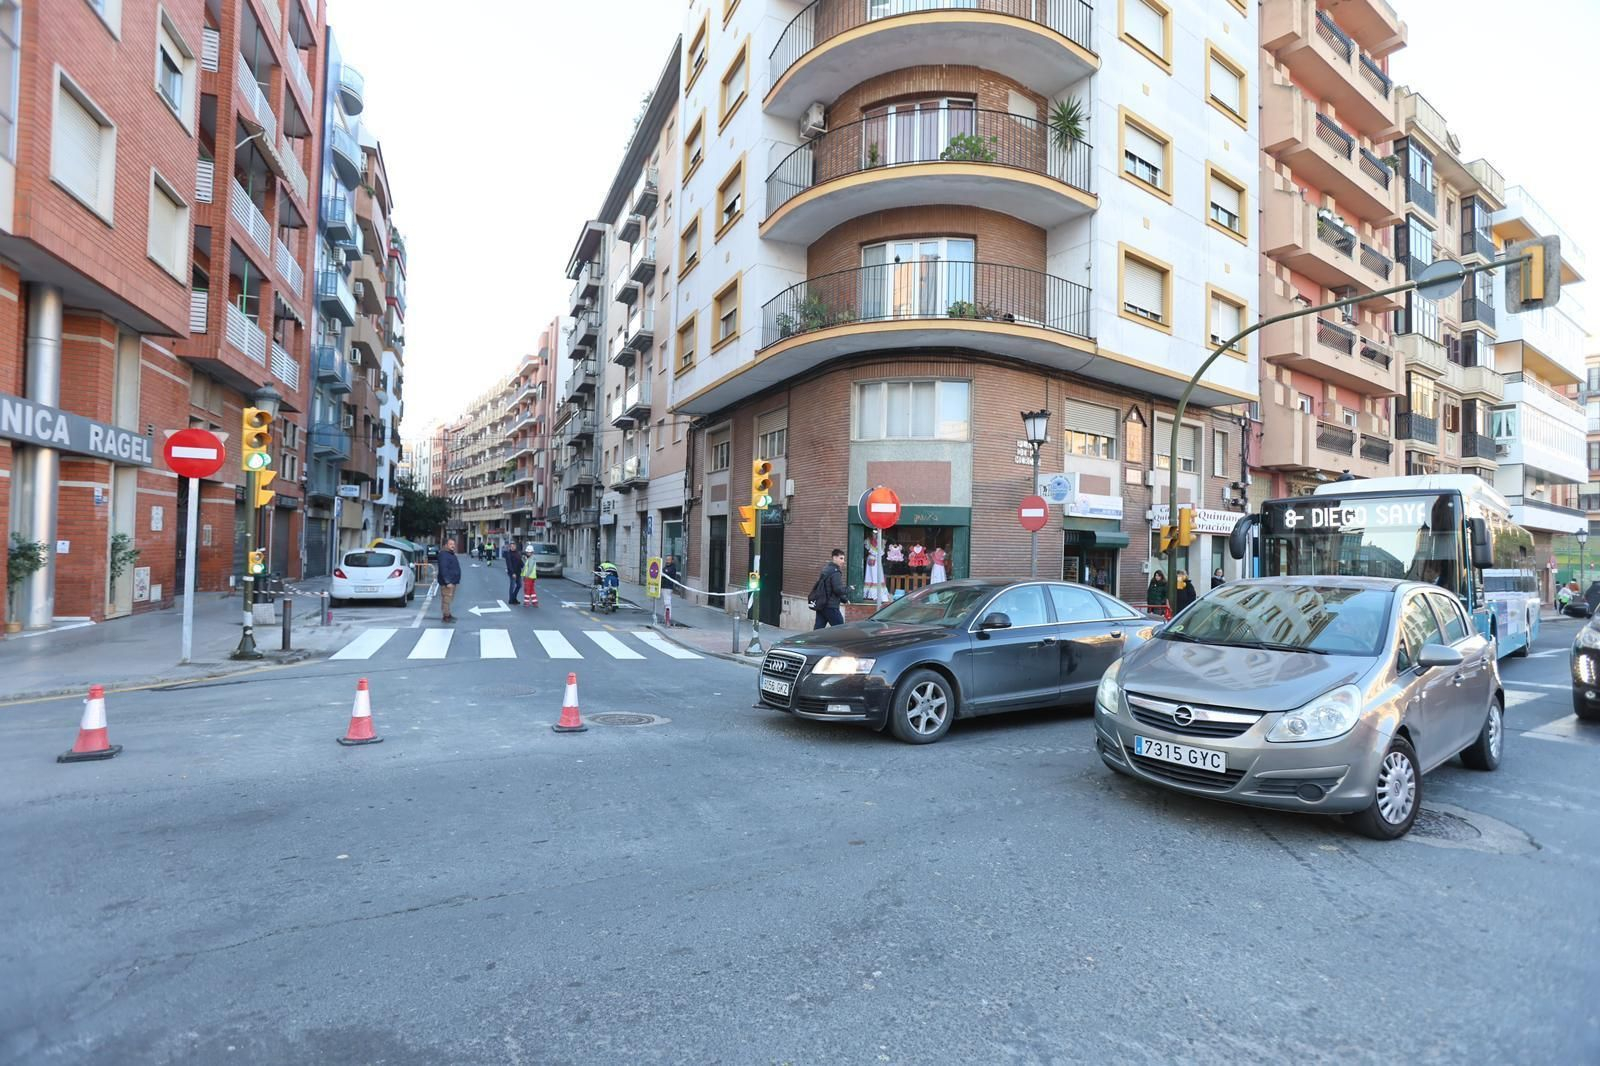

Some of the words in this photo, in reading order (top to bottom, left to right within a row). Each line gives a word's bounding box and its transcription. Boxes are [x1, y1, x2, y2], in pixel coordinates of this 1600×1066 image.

[1, 398, 71, 446] NICA
[89, 423, 153, 463] RAGEL
[1311, 506, 1368, 528] DIEGO
[1145, 740, 1182, 761] 7315
[1188, 749, 1221, 769] GYC
